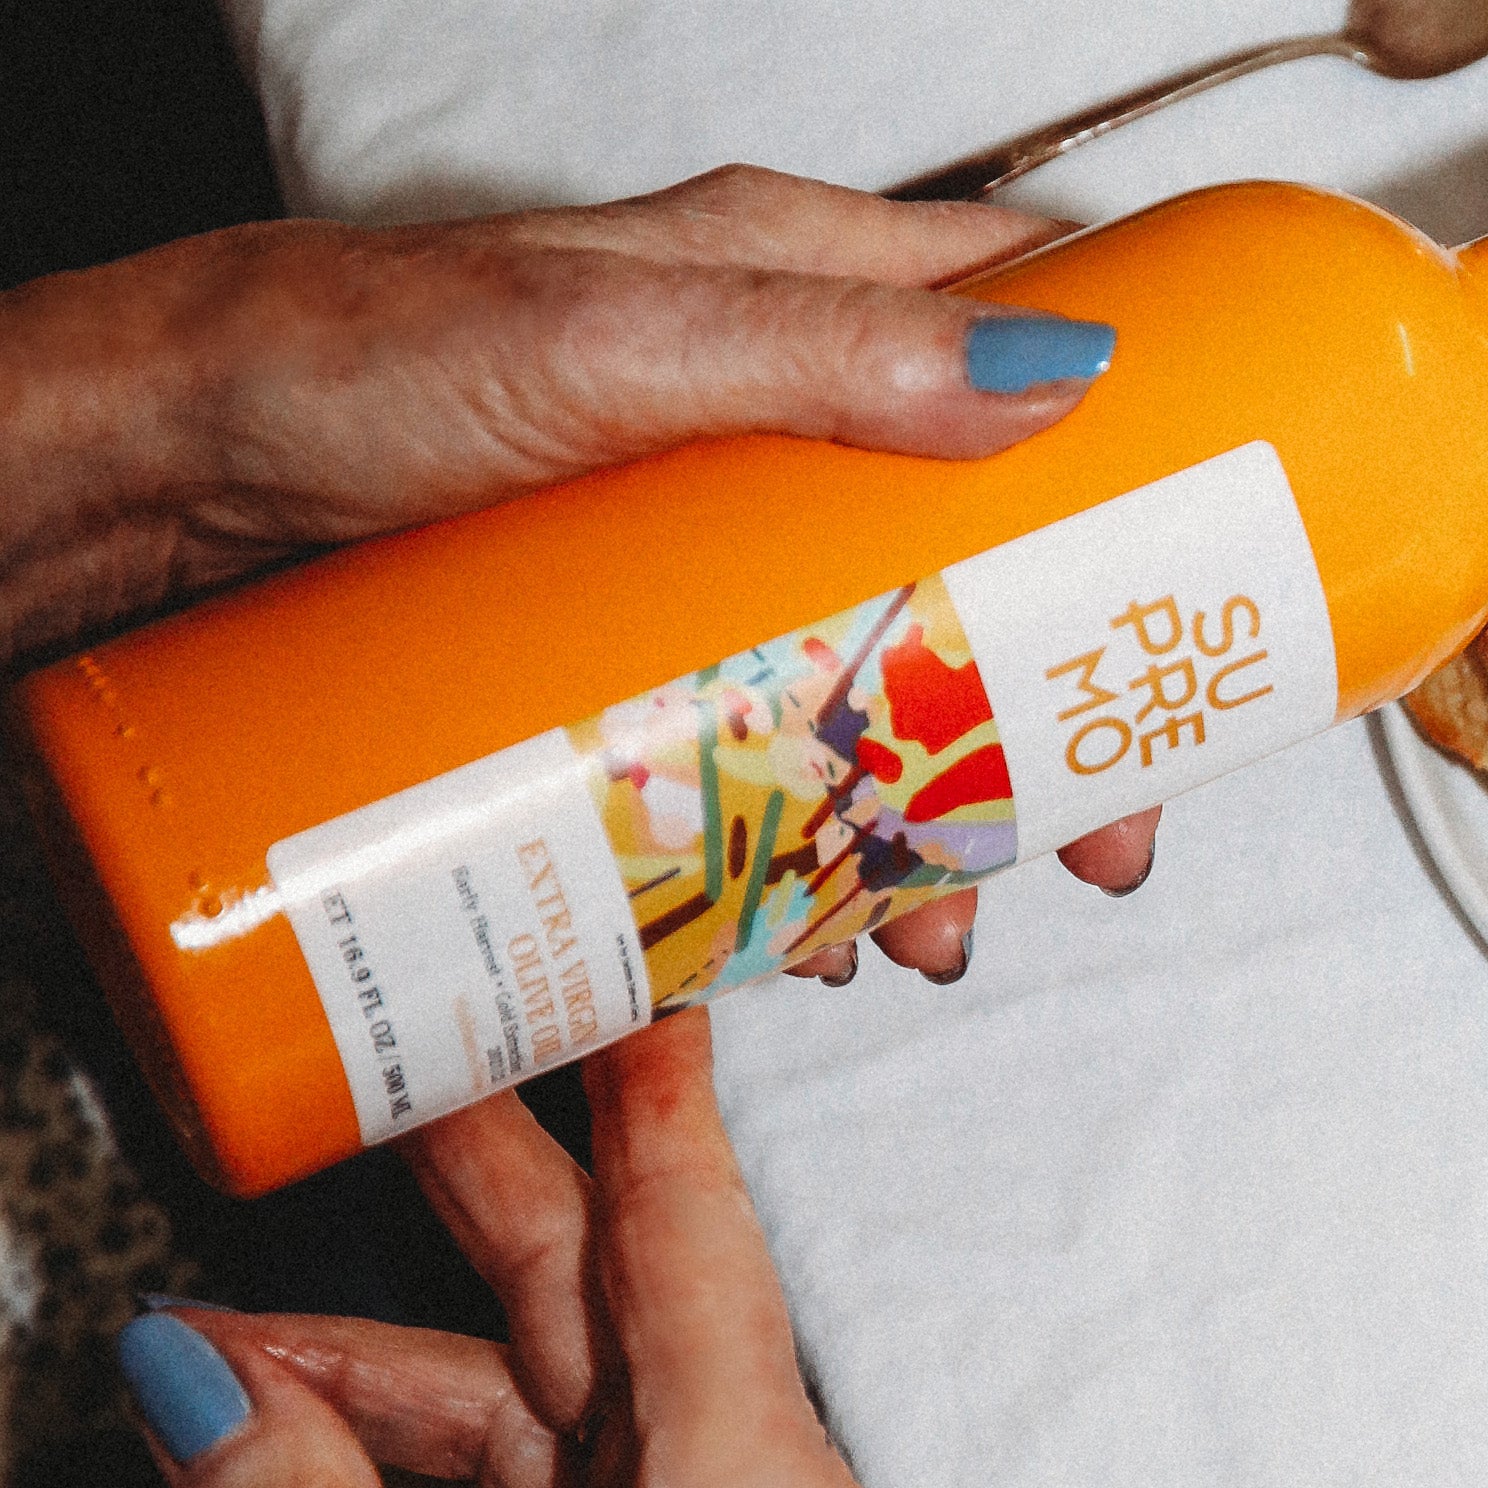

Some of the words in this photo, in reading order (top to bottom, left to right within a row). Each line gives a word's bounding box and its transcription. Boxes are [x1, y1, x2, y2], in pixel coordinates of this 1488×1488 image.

[1109, 594, 1206, 769] PRE
[1191, 594, 1274, 711] SU
[1044, 644, 1133, 776] MO
[452, 865, 480, 913] Early
[470, 914, 501, 978] Harvest
[516, 837, 578, 959] EXTRA
[558, 959, 598, 1044] VIRGIN
[339, 936, 371, 985] 16.9
[507, 933, 557, 1025] OLIVE
[357, 986, 384, 1019] FL
[369, 1019, 397, 1054] OZ
[383, 1063, 405, 1095] 500
[531, 1024, 563, 1064] OIL
[391, 1092, 413, 1120] ML
